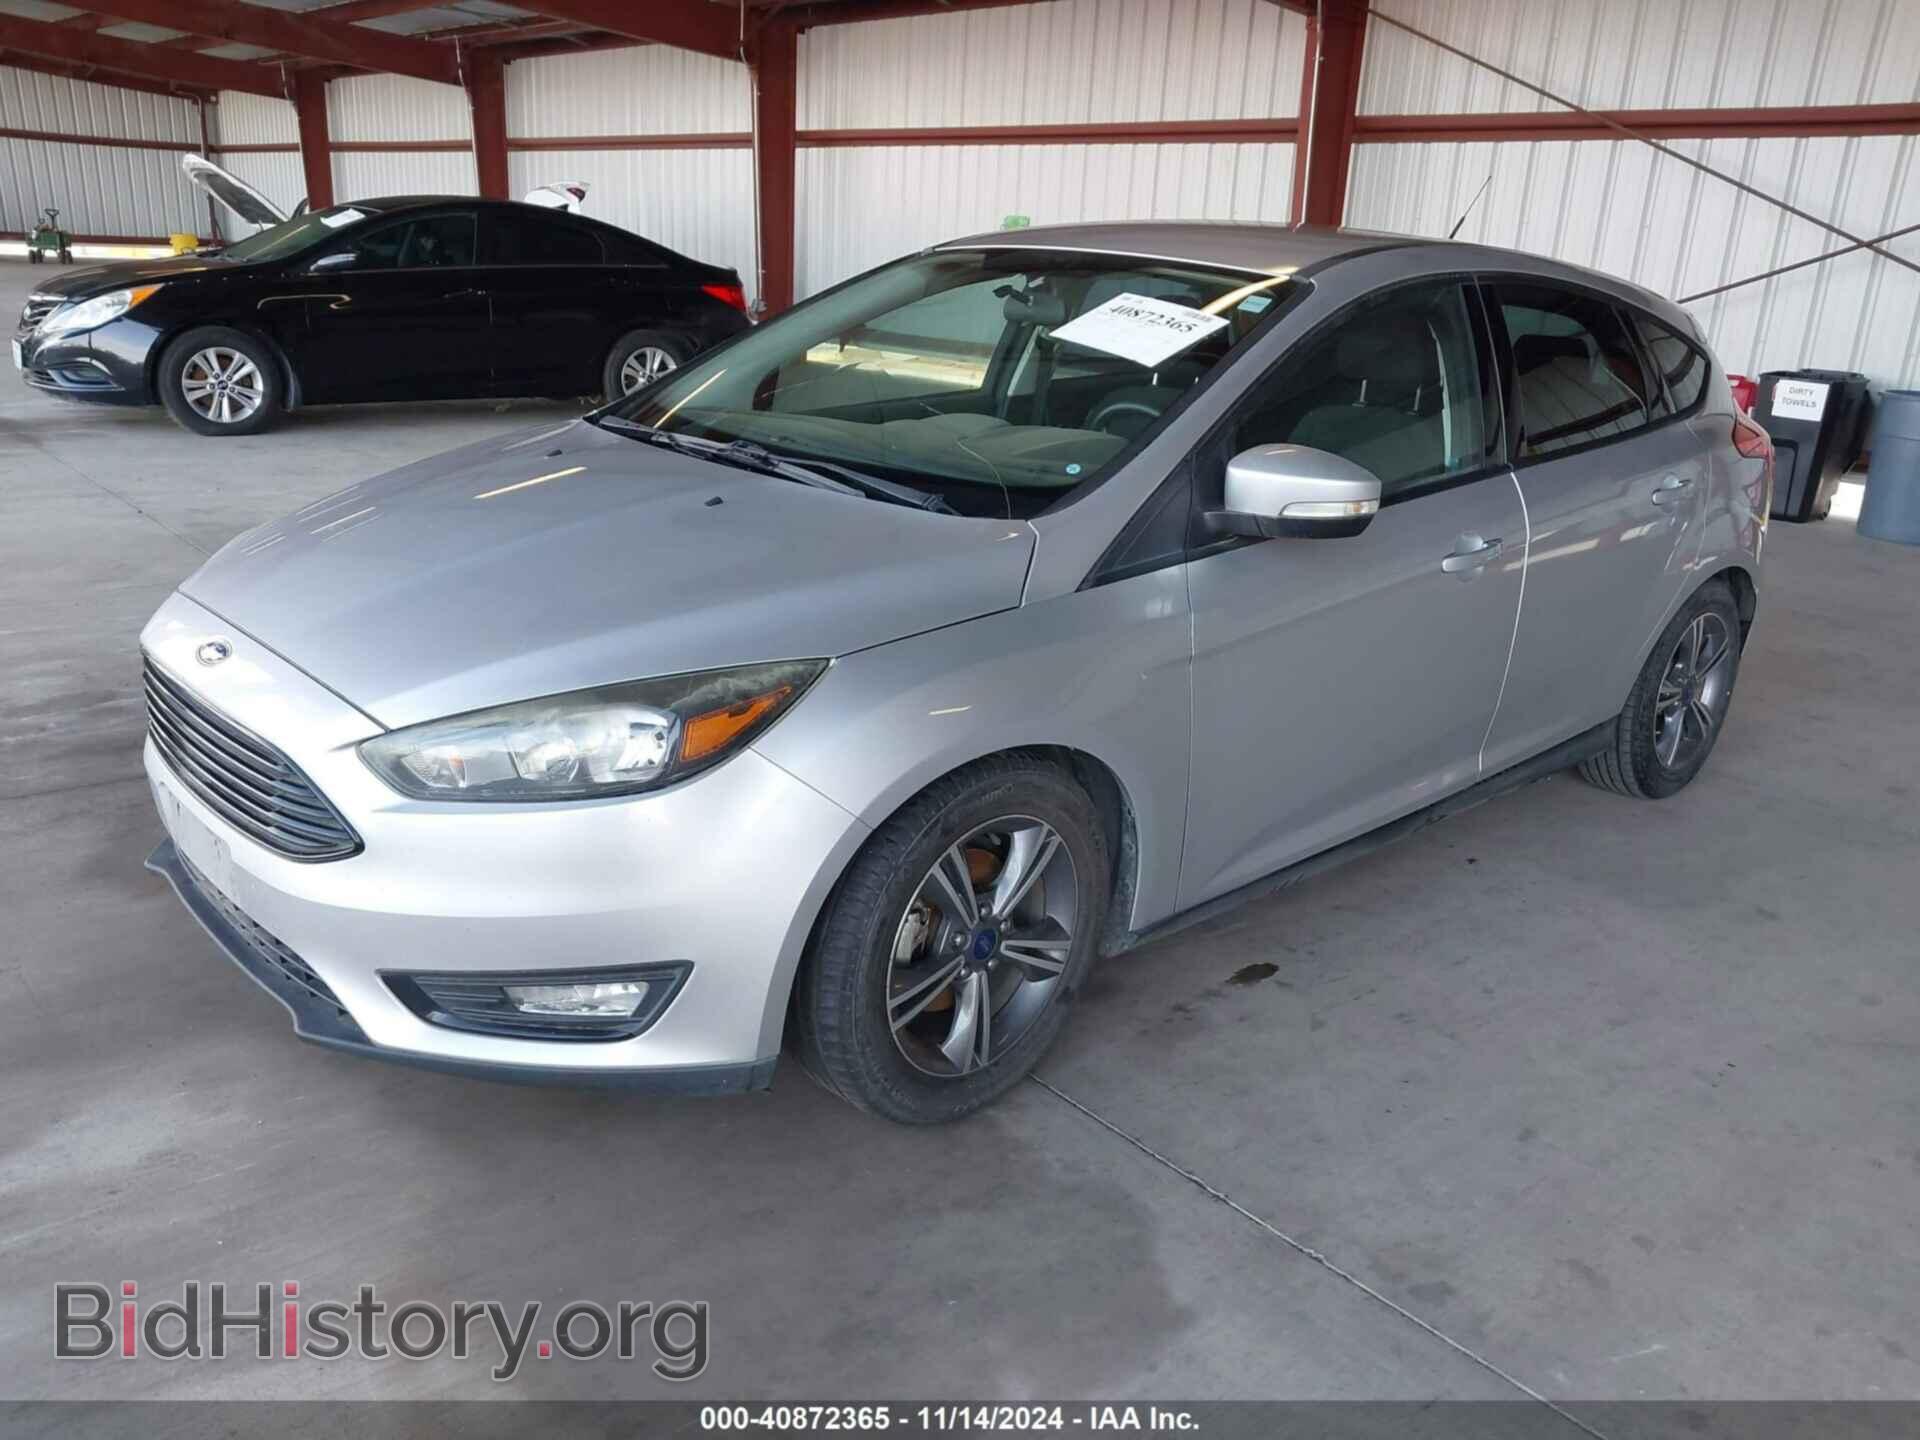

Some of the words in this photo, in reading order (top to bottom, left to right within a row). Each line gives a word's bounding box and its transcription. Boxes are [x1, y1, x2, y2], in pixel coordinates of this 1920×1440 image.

[1109, 304, 1198, 333] 40872365
[1788, 386, 1814, 396] DIRTY
[1782, 397, 1817, 408] TOWELS
